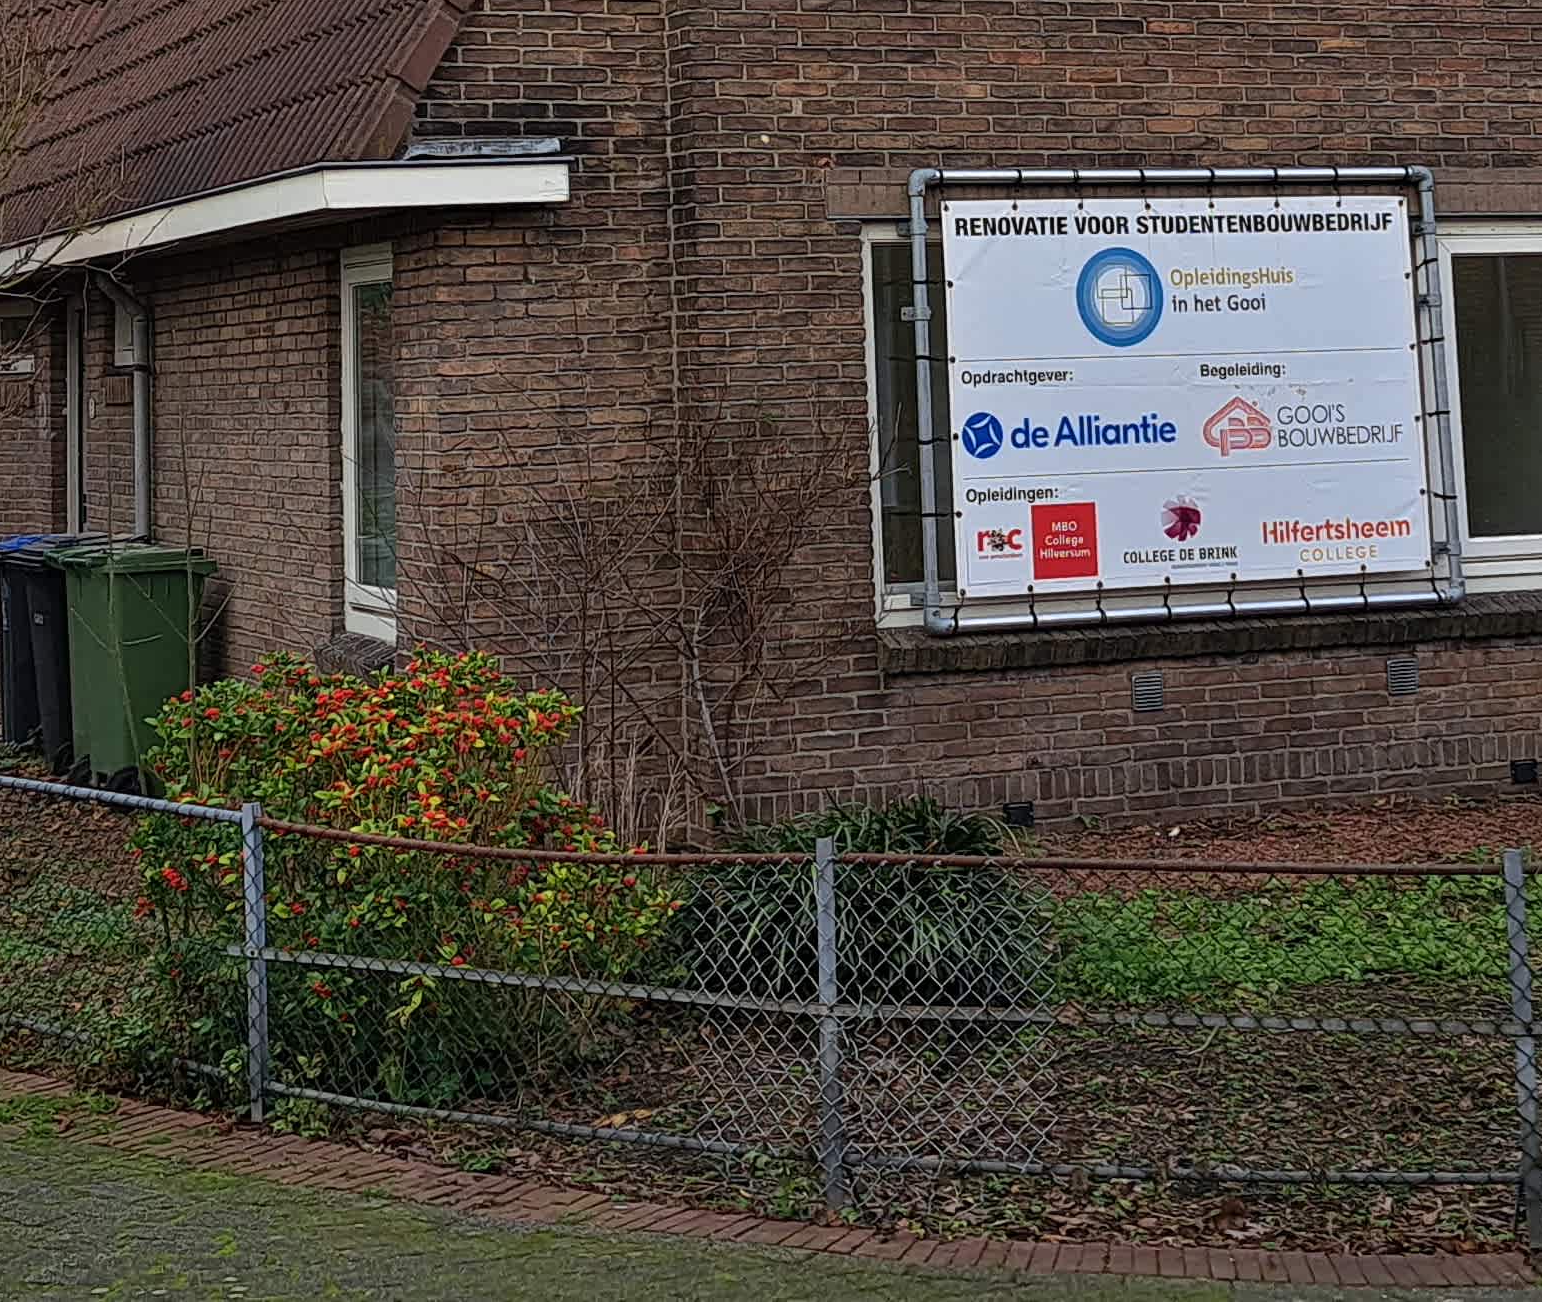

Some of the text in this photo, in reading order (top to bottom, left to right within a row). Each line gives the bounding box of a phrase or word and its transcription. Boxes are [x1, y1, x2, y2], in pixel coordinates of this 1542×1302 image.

[955, 212, 1393, 236] RENOVATIE VOOR STUDENTENBOUWBEDRIJF
[1170, 266, 1294, 289] OpleidingsHuis
[1172, 293, 1266, 313] in het Gooi
[961, 370, 1074, 387] Opdrachtgever:
[1200, 362, 1286, 379] Begeleiding:
[1277, 404, 1346, 425] GOOI'S
[1011, 413, 1177, 448] de Alliantie
[1278, 424, 1403, 448] BOUWBEDRIJF
[966, 487, 1059, 504] Opleidingen:
[1051, 521, 1077, 532] MBO
[1262, 518, 1411, 544] Hilfertsheem
[1045, 535, 1084, 546] College
[1040, 548, 1090, 559] Hilversum
[1123, 546, 1238, 564] COLLEGE DE BRINK
[1300, 545, 1378, 562] COLLEGE
